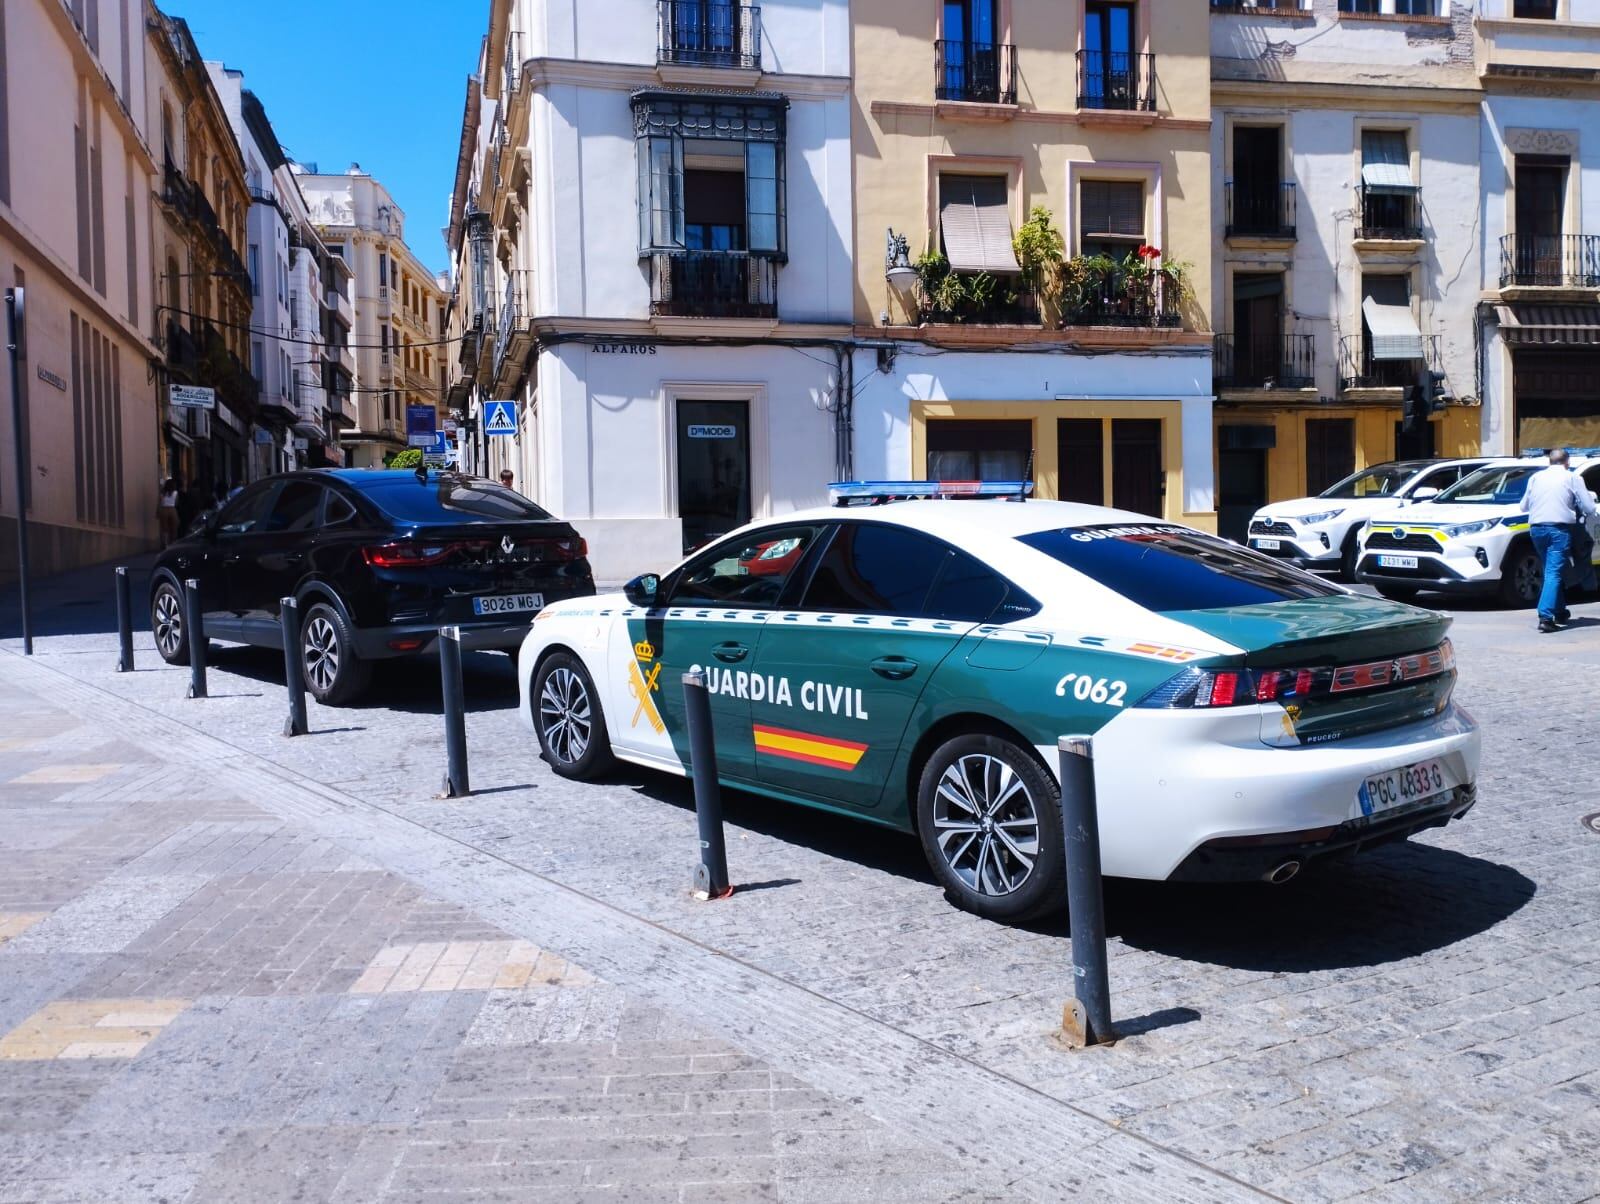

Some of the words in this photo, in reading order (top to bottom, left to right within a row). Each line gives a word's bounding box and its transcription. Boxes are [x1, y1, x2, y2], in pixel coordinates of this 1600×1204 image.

[592, 344, 656, 354] ALFAROS
[1070, 526, 1162, 542] GUARDIA
[474, 557, 541, 565] ARKANA
[482, 598, 514, 612] 9026
[517, 595, 541, 609] MGJ
[1074, 675, 1128, 707] 062
[800, 680, 869, 720] CIVIL
[1307, 732, 1341, 742] PEUGEOT
[1368, 777, 1397, 808] PGC
